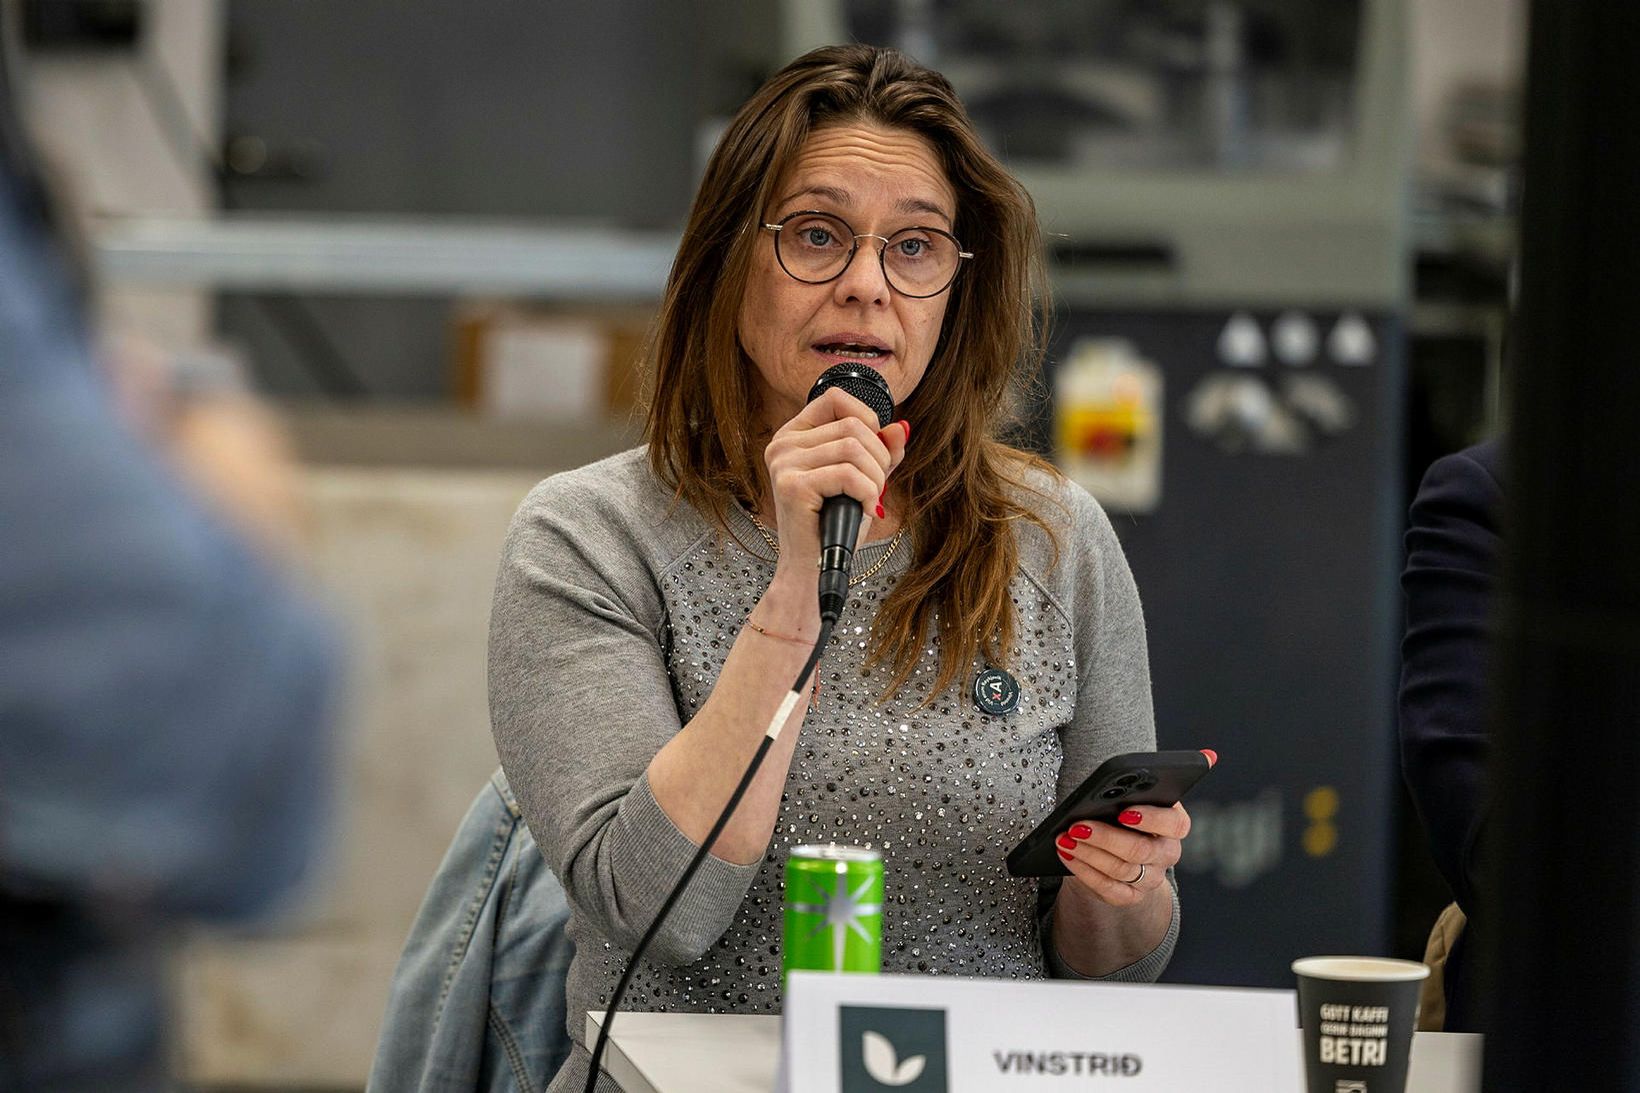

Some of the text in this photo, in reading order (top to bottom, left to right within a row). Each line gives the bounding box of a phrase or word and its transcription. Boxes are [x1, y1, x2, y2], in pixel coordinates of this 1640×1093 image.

[1352, 1006, 1389, 1023] KAFFI
[993, 1050, 1142, 1077] VINSTRIÐ
[1320, 1036, 1388, 1066] BETRI
